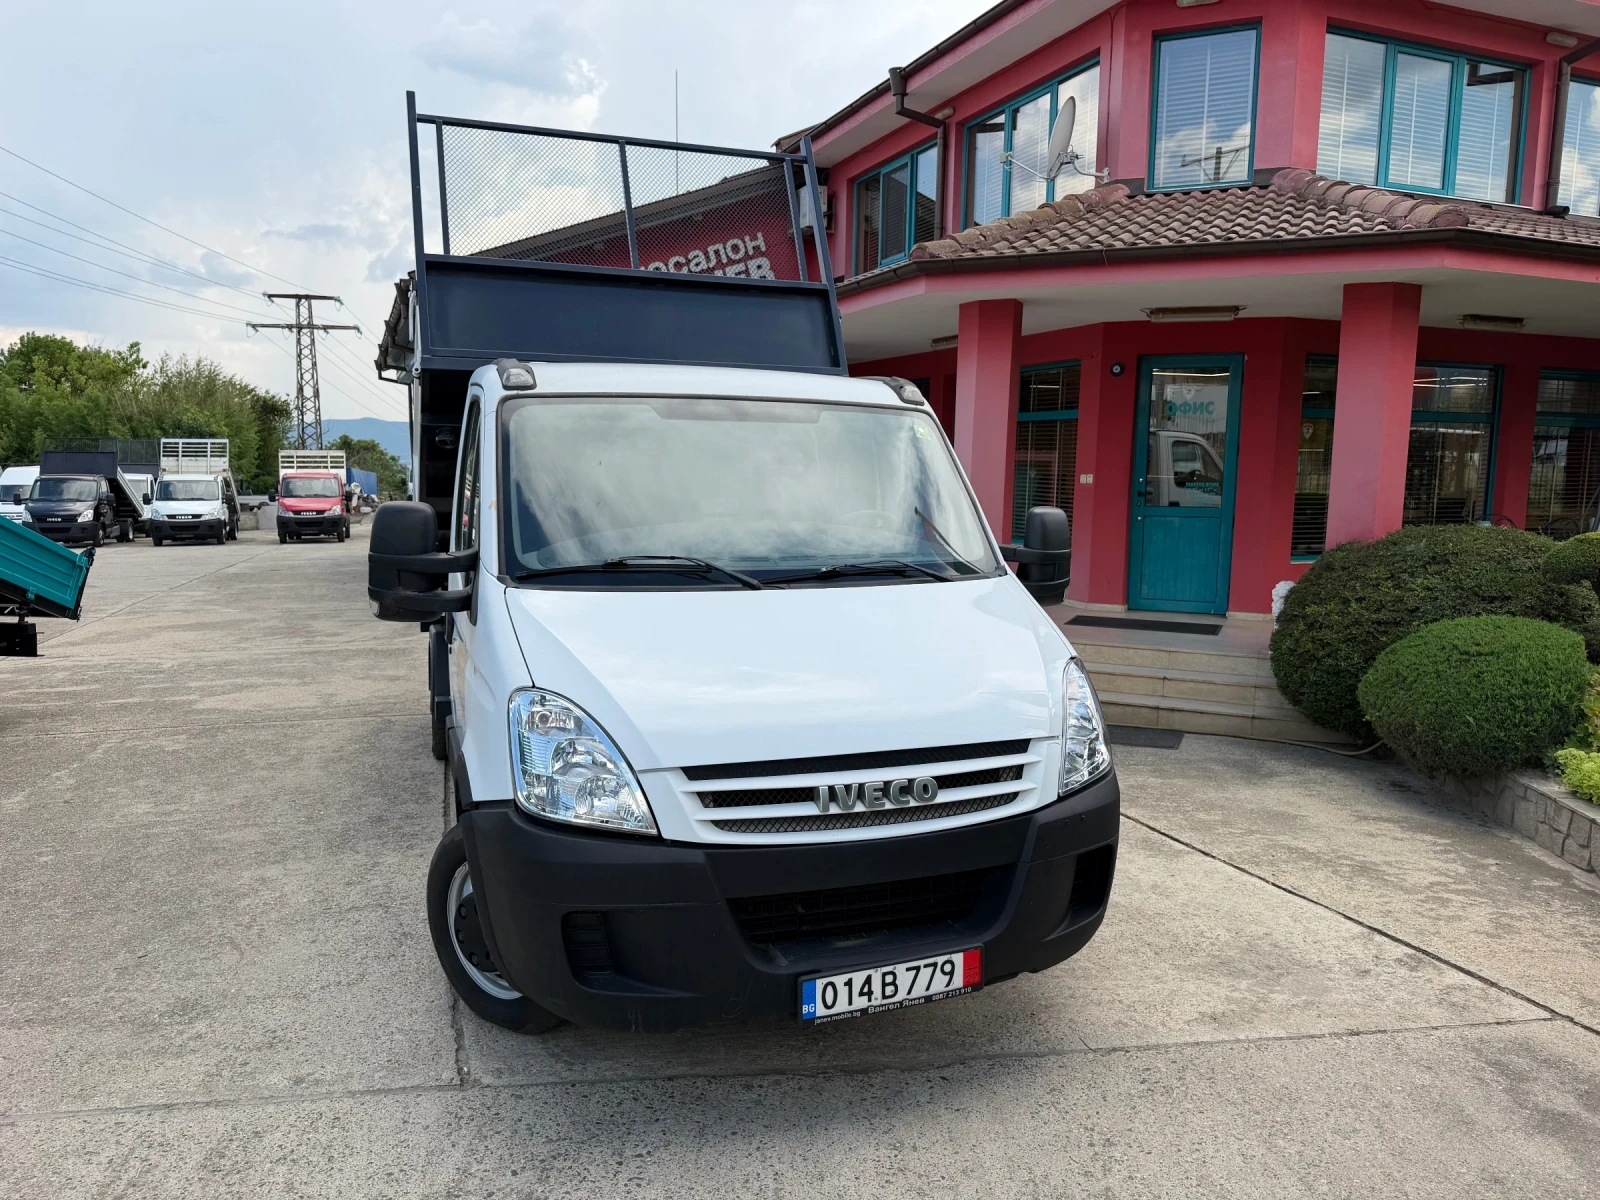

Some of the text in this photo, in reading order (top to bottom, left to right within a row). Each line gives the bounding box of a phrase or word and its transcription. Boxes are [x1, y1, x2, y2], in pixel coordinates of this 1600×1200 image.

[1165, 401, 1215, 416] ОФИС
[816, 776, 939, 813] IVECO
[802, 1004, 816, 1014] BG
[868, 997, 925, 1014] Вангел Янев
[814, 1011, 861, 1025] janev.mobile.bg
